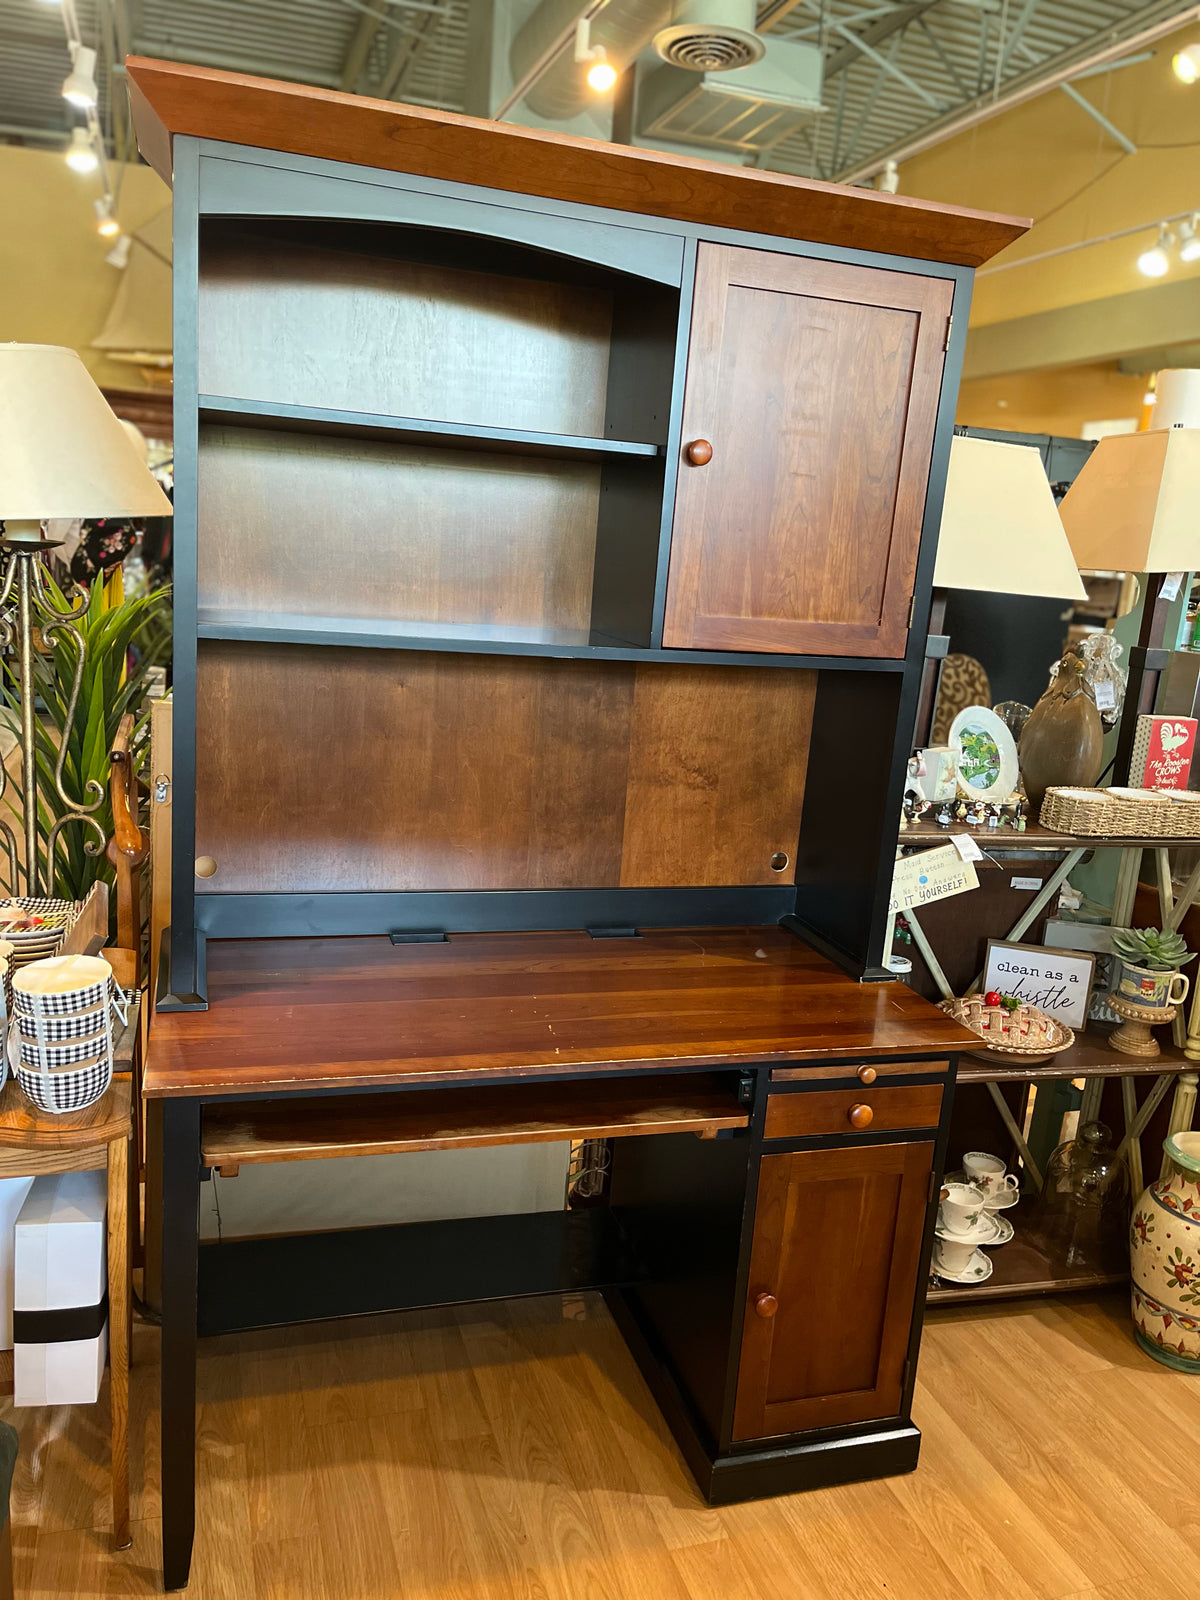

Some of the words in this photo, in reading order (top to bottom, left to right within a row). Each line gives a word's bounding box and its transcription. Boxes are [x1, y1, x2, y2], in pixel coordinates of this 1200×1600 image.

[1149, 761, 1162, 769] The
[1164, 758, 1189, 768] Rooster
[1155, 766, 1181, 777] CROWS
[904, 894, 915, 906] IT
[919, 877, 968, 902] YOURSELF!
[997, 962, 1039, 977] clean
[1045, 970, 1063, 981] as
[1069, 974, 1079, 983] a
